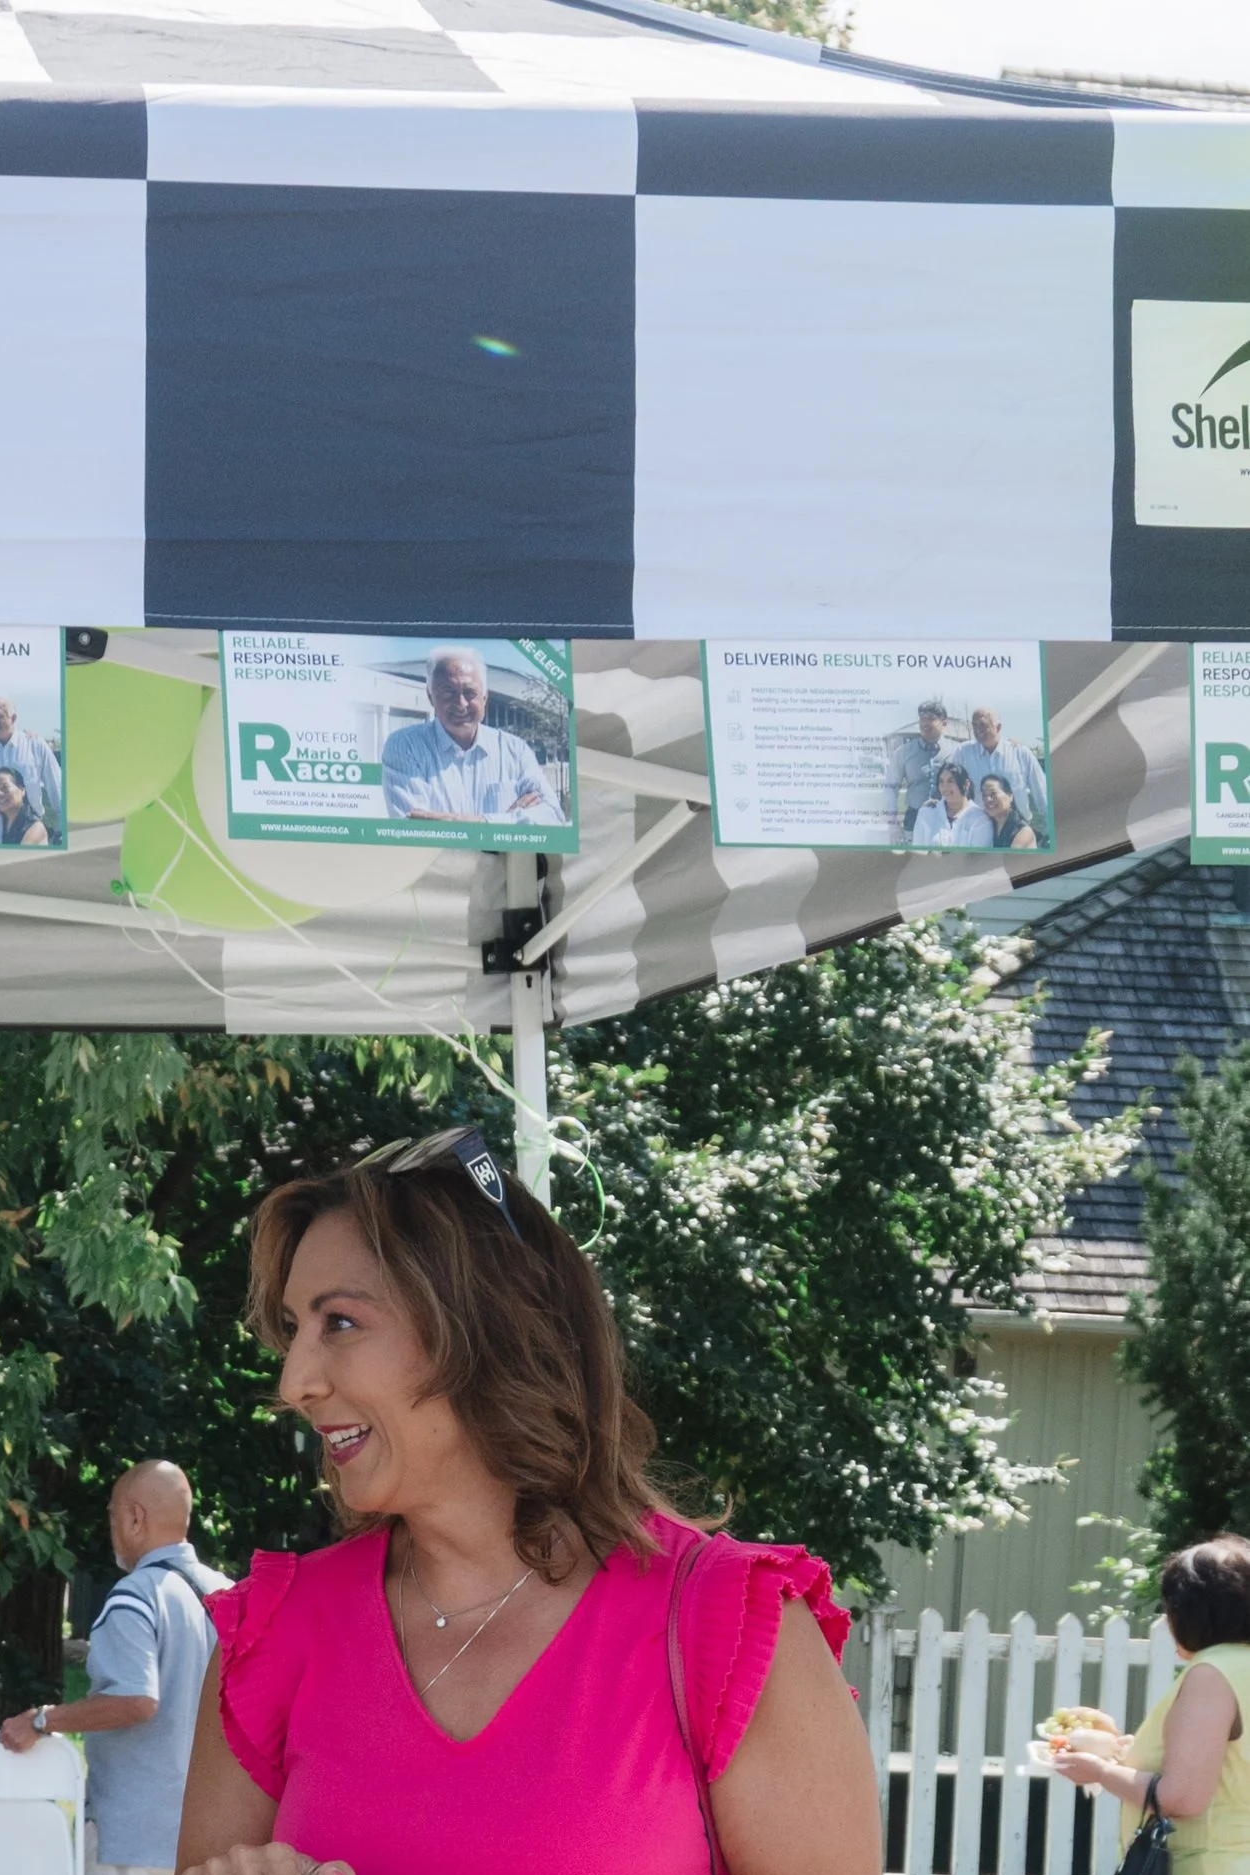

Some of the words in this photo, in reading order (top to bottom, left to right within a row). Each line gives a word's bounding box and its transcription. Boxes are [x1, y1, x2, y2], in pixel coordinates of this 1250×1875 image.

[1171, 403, 1250, 449] Shel
[232, 636, 309, 650] RELIABLE.
[234, 651, 344, 666] RESPONSIBLE.
[518, 638, 567, 680] RE-ELECT
[724, 652, 817, 666] DELIVERING
[823, 653, 892, 667] RESULTS
[897, 654, 928, 668] FOR
[932, 654, 1011, 668] VAUGHAN
[234, 667, 336, 682] RESPONSIVE.
[1203, 668, 1250, 680] RESPO
[1203, 685, 1250, 697] RESPO
[296, 731, 329, 743] VOTE
[333, 732, 357, 744] FOR
[296, 747, 340, 760] Mario
[348, 748, 362, 760] G.
[253, 789, 290, 797] CANDIDATE
[337, 792, 370, 800] REGIONAL
[260, 823, 349, 834] WWW.MARIOGRACCO.CA
